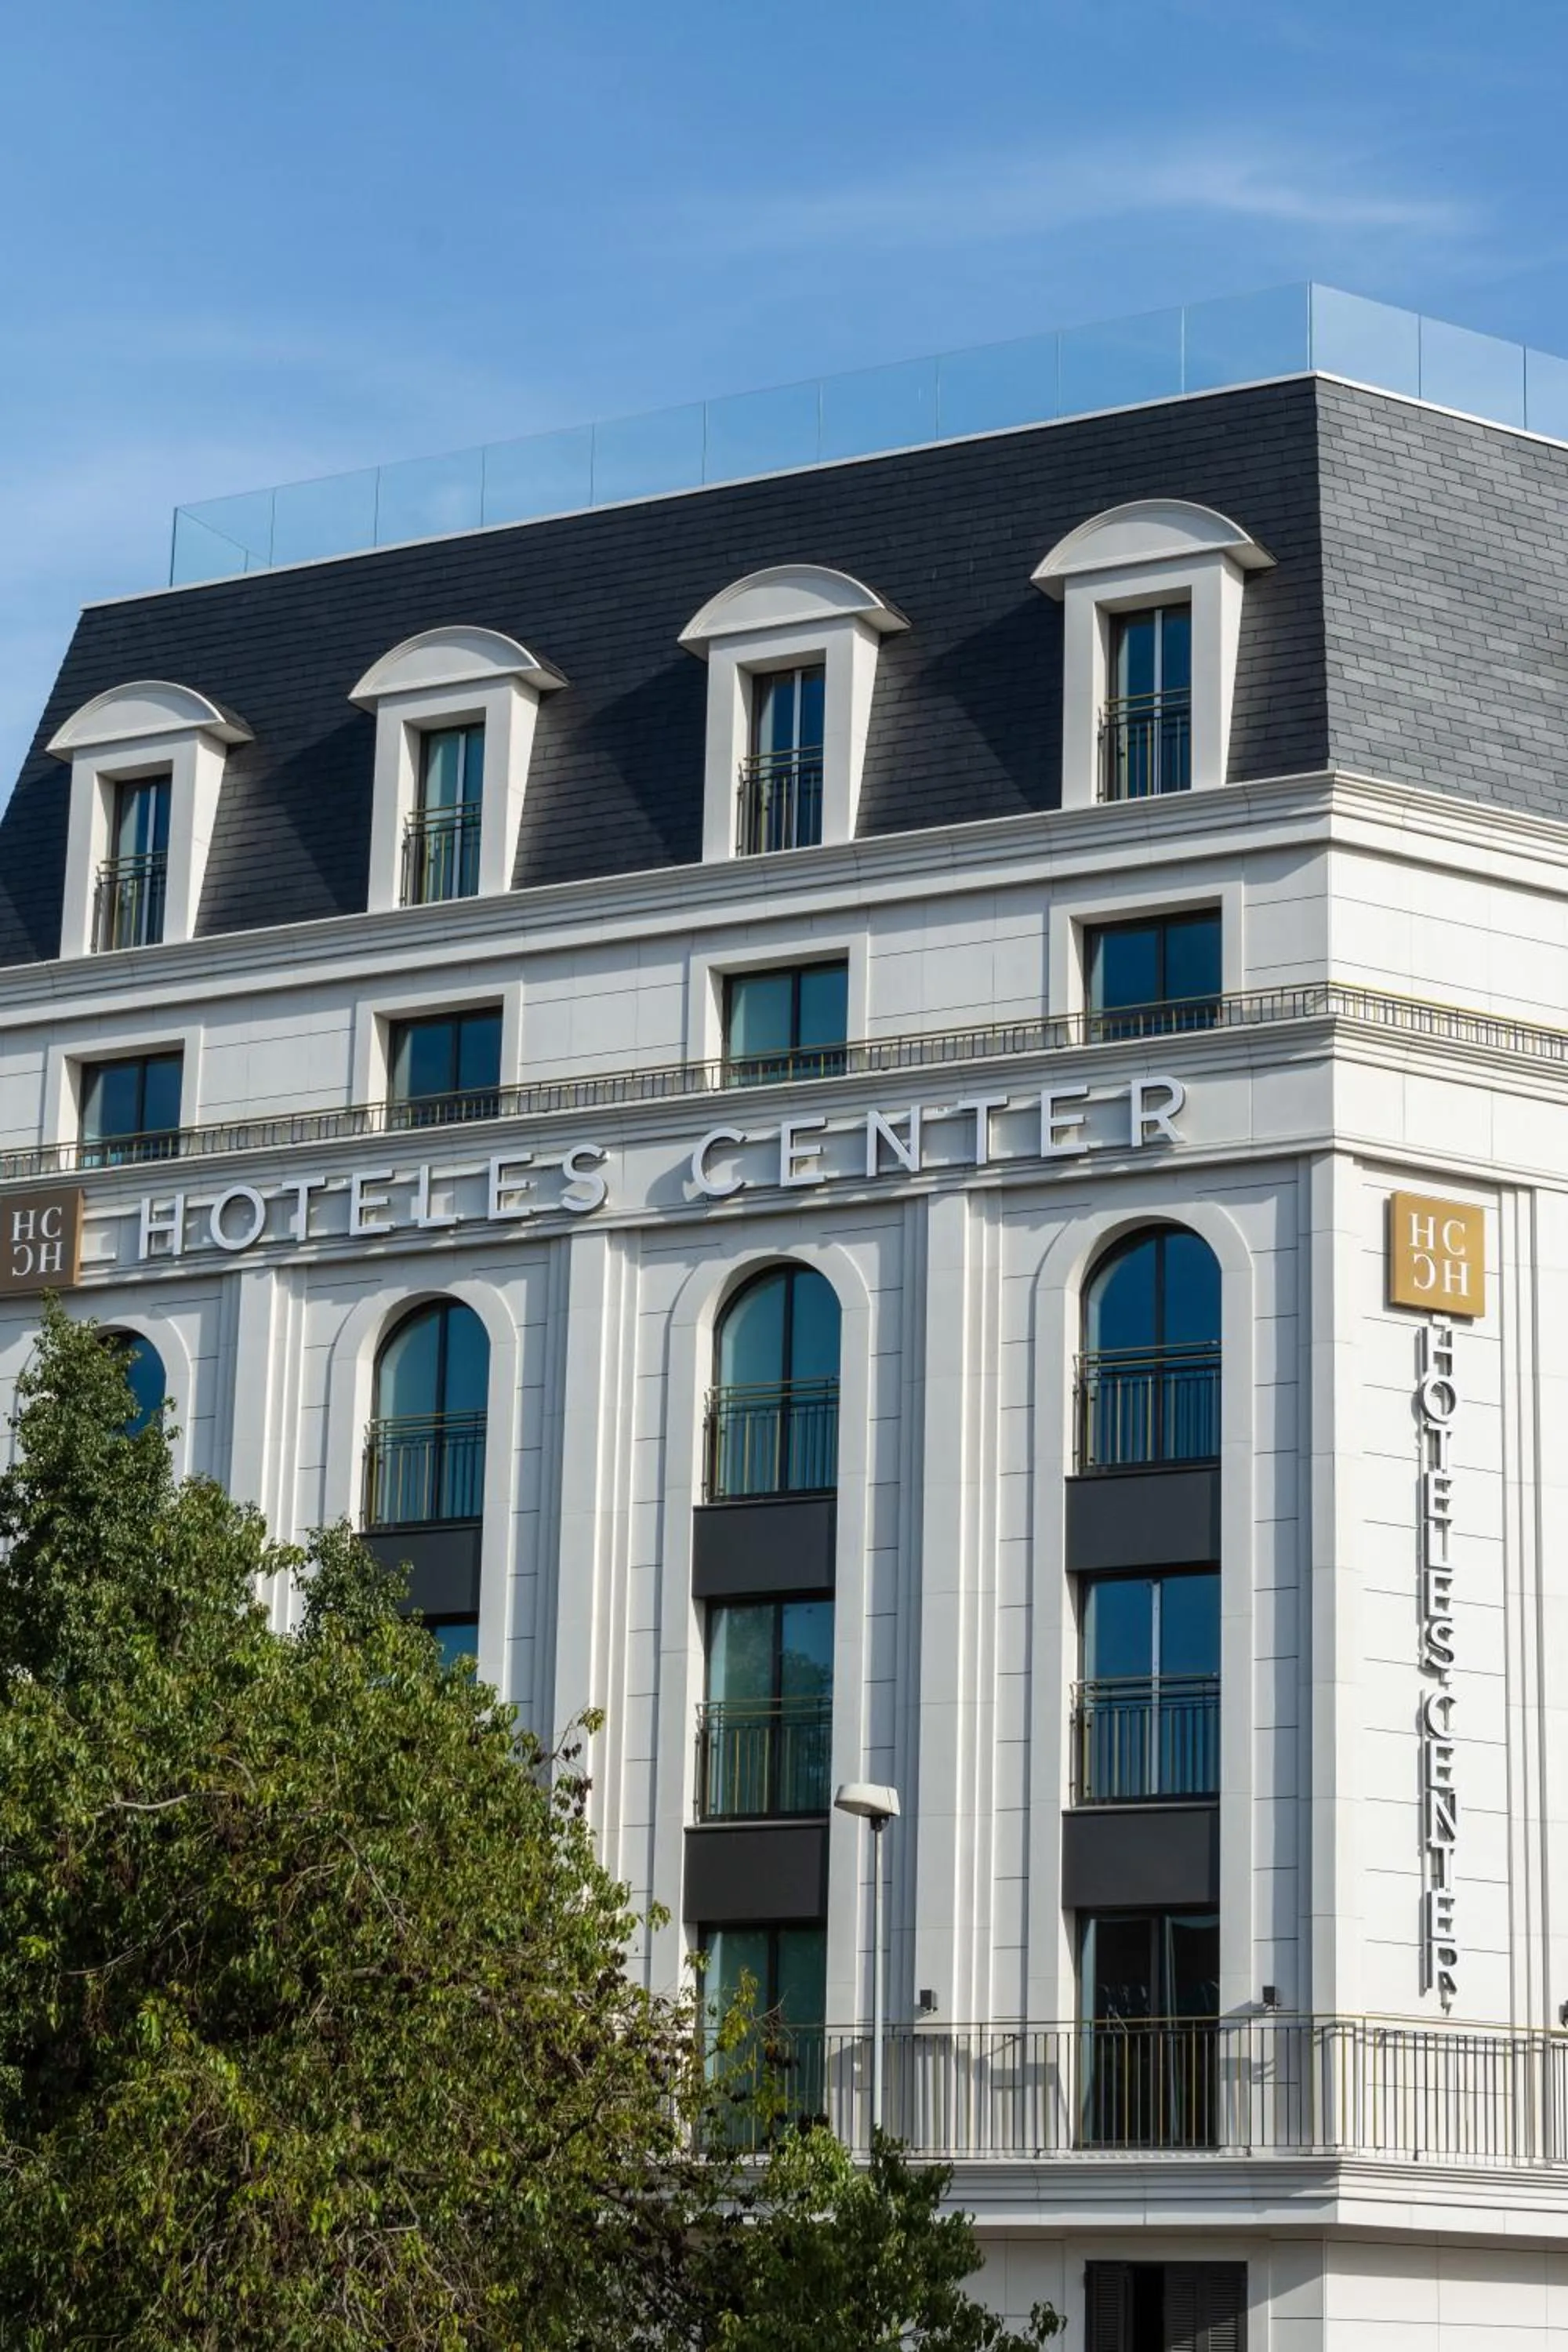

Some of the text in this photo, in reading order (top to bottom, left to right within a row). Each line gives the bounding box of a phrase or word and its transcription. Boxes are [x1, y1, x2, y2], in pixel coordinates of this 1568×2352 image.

[11, 1206, 62, 1241] HC
[138, 1076, 1185, 1259] HOTELES CENTER
[1409, 1212, 1466, 1256] HC
[1423, 1325, 1461, 1994] HOTELES CENTER
